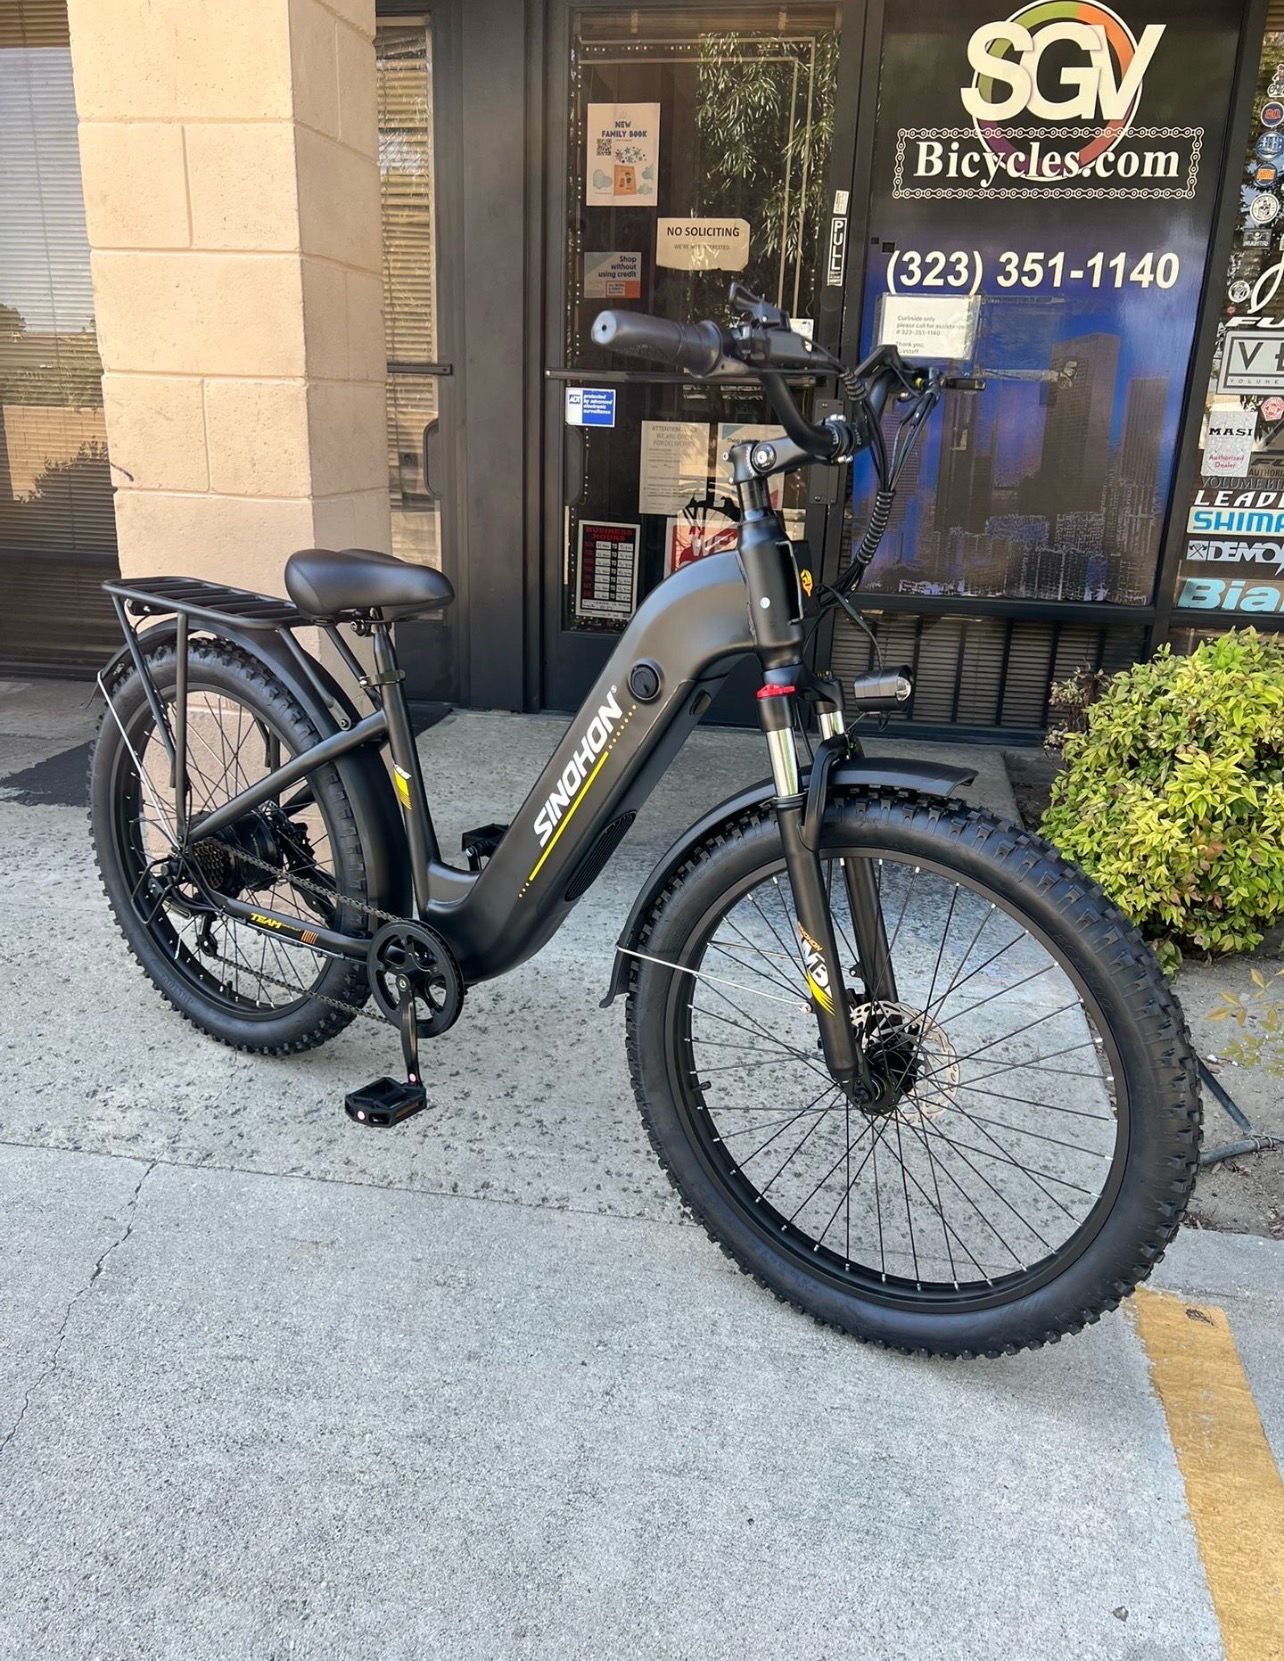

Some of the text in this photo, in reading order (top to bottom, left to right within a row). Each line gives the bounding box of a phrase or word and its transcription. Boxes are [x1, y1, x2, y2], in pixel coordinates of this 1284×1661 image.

[960, 21, 1166, 121] SGV
[913, 141, 1180, 188] Bicycles.com
[667, 226, 740, 237] NO SOLICITING
[831, 220, 843, 270] PULL
[619, 255, 637, 264] Shop
[598, 271, 616, 279] using
[886, 250, 1181, 294] (323) 351-1140
[1208, 427, 1253, 436] MASI
[1208, 454, 1244, 463] Authorized
[1214, 461, 1236, 469] Dealer
[1207, 540, 1284, 570] DEMO
[1177, 577, 1284, 613] Bia
[533, 690, 623, 847] SINOHON
[250, 912, 282, 929] TEAM
